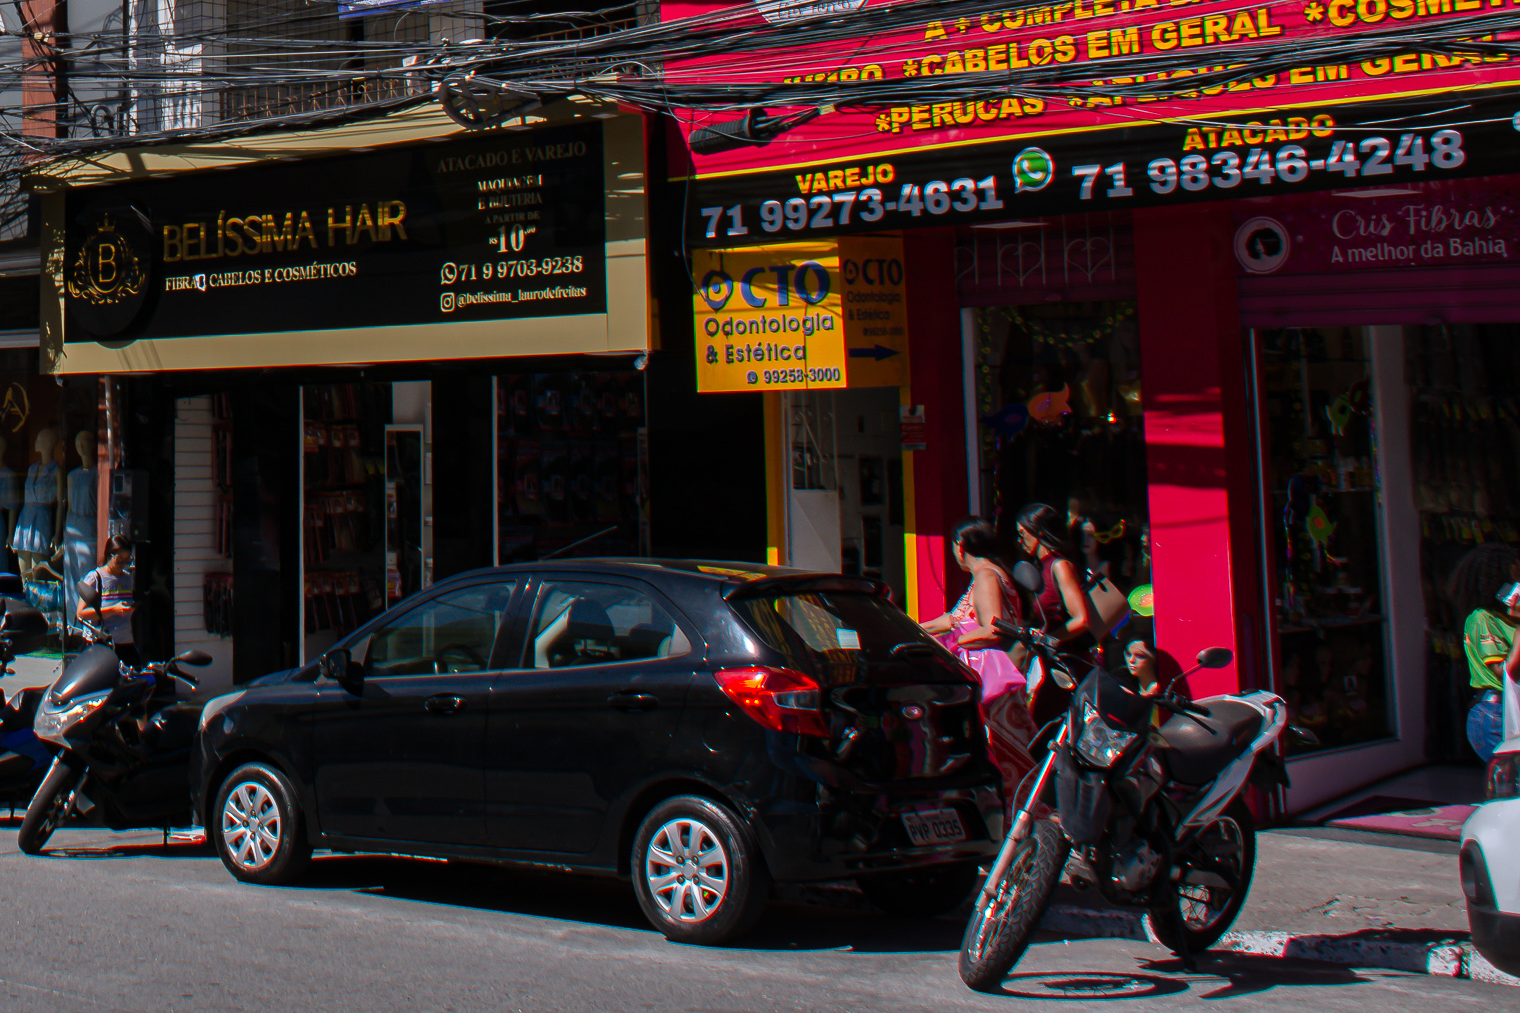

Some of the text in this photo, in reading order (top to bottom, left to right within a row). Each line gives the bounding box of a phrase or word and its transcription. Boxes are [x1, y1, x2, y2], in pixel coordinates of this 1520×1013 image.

[1087, 27, 1142, 60] EM
[1151, 8, 1284, 51] GERAL
[437, 141, 587, 173] ATACADO E VAREJO
[795, 114, 1336, 194] VAREJO ATACADO
[1072, 129, 1467, 200] 71 98346-4248
[492, 212, 525, 224] PARTIR
[701, 176, 1005, 238] 71 99273-4631
[1332, 204, 1500, 240] Cris Fibras
[163, 199, 409, 262] BELÍSSIMA HAIR
[98, 243, 117, 283] B
[1331, 236, 1507, 264] A melhor da Bahia
[209, 269, 262, 288] CABELOS
[264, 267, 273, 283] E
[275, 261, 357, 284] COSMÉTICOS
[459, 255, 584, 282] 71 9 9703-9238
[842, 258, 904, 286] OCTO
[701, 260, 831, 312] OCTO
[703, 312, 834, 337] Odontologia
[705, 341, 806, 364] & Estética
[762, 366, 841, 383] 99258-3000
